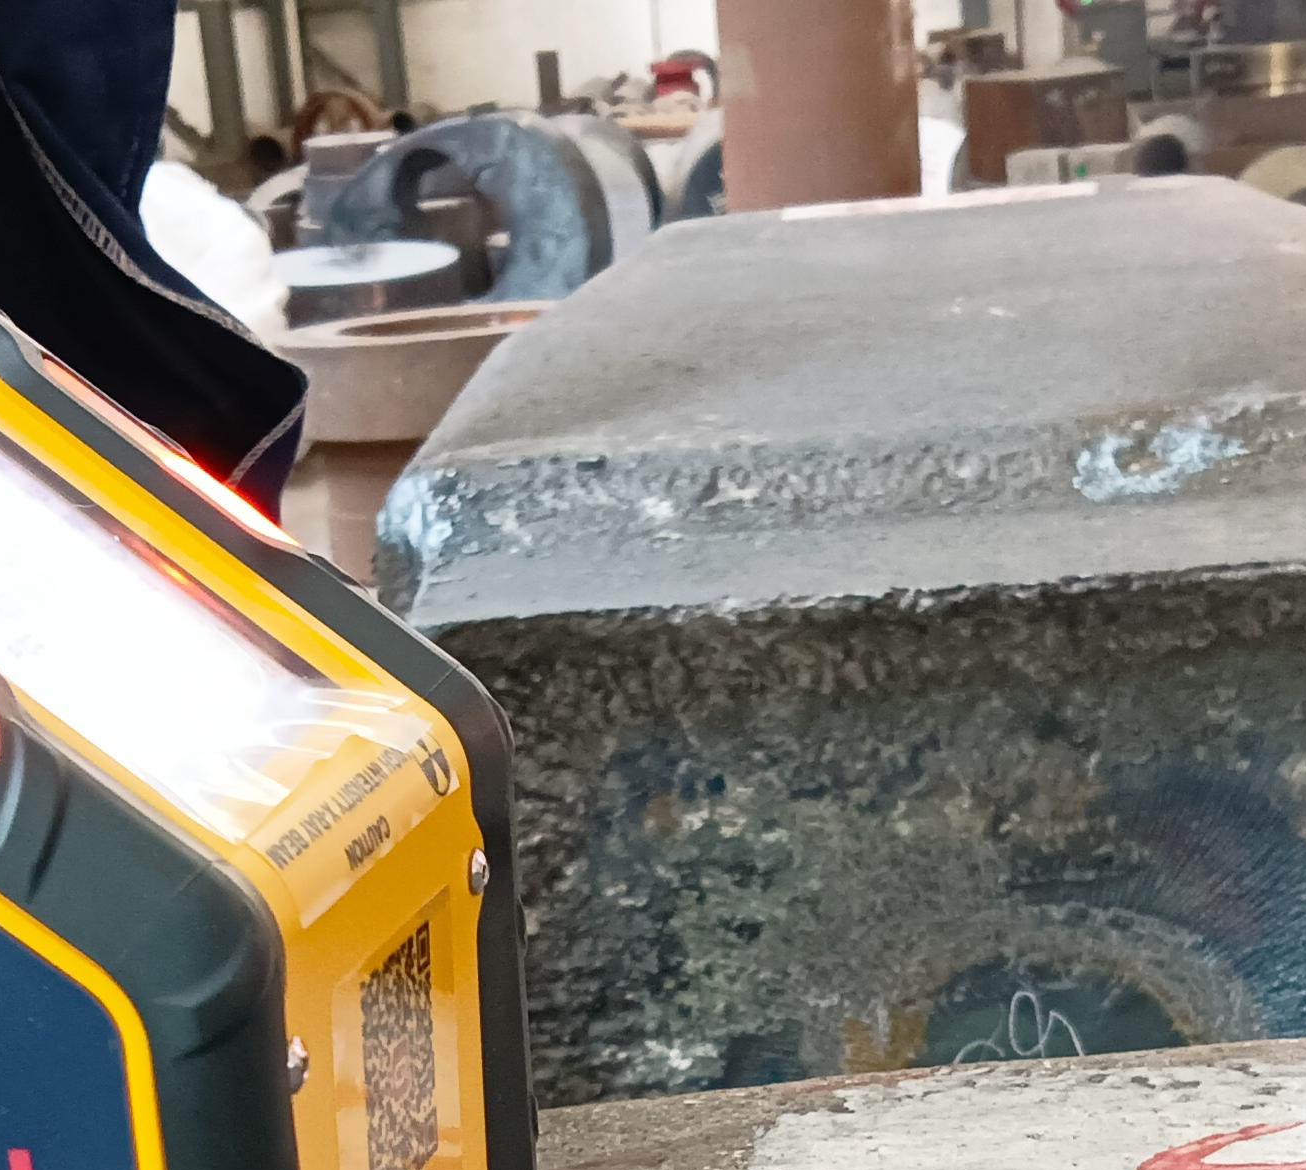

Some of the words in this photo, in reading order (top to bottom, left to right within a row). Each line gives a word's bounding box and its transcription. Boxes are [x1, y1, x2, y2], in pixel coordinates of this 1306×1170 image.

[330, 760, 389, 817] INTENSITY
[298, 800, 343, 843] X-RAY
[344, 815, 391, 871] CAUTION
[266, 829, 310, 871] BEAM
